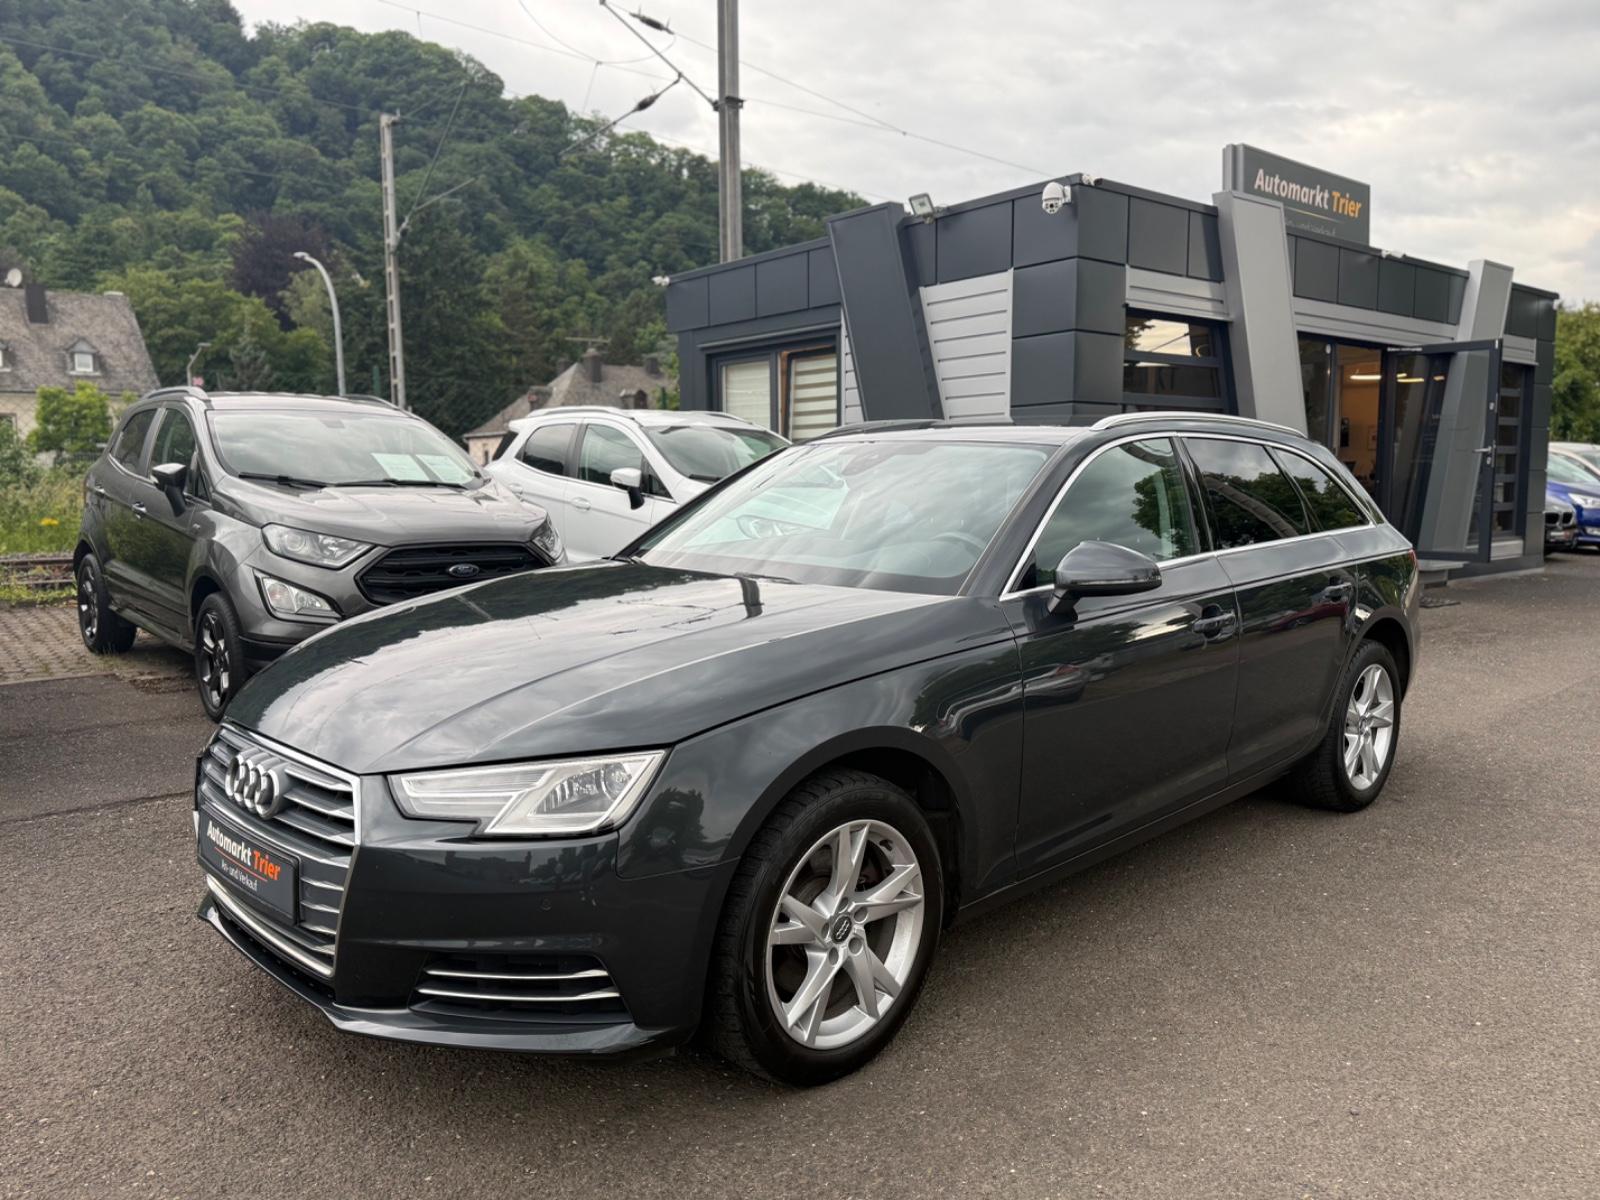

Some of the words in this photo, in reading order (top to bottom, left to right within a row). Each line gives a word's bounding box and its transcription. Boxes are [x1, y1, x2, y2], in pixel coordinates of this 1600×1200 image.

[1254, 168, 1329, 209] Automarkt
[1331, 191, 1361, 218] Trier
[207, 820, 251, 866] Automarkt
[253, 850, 281, 880] Trier
